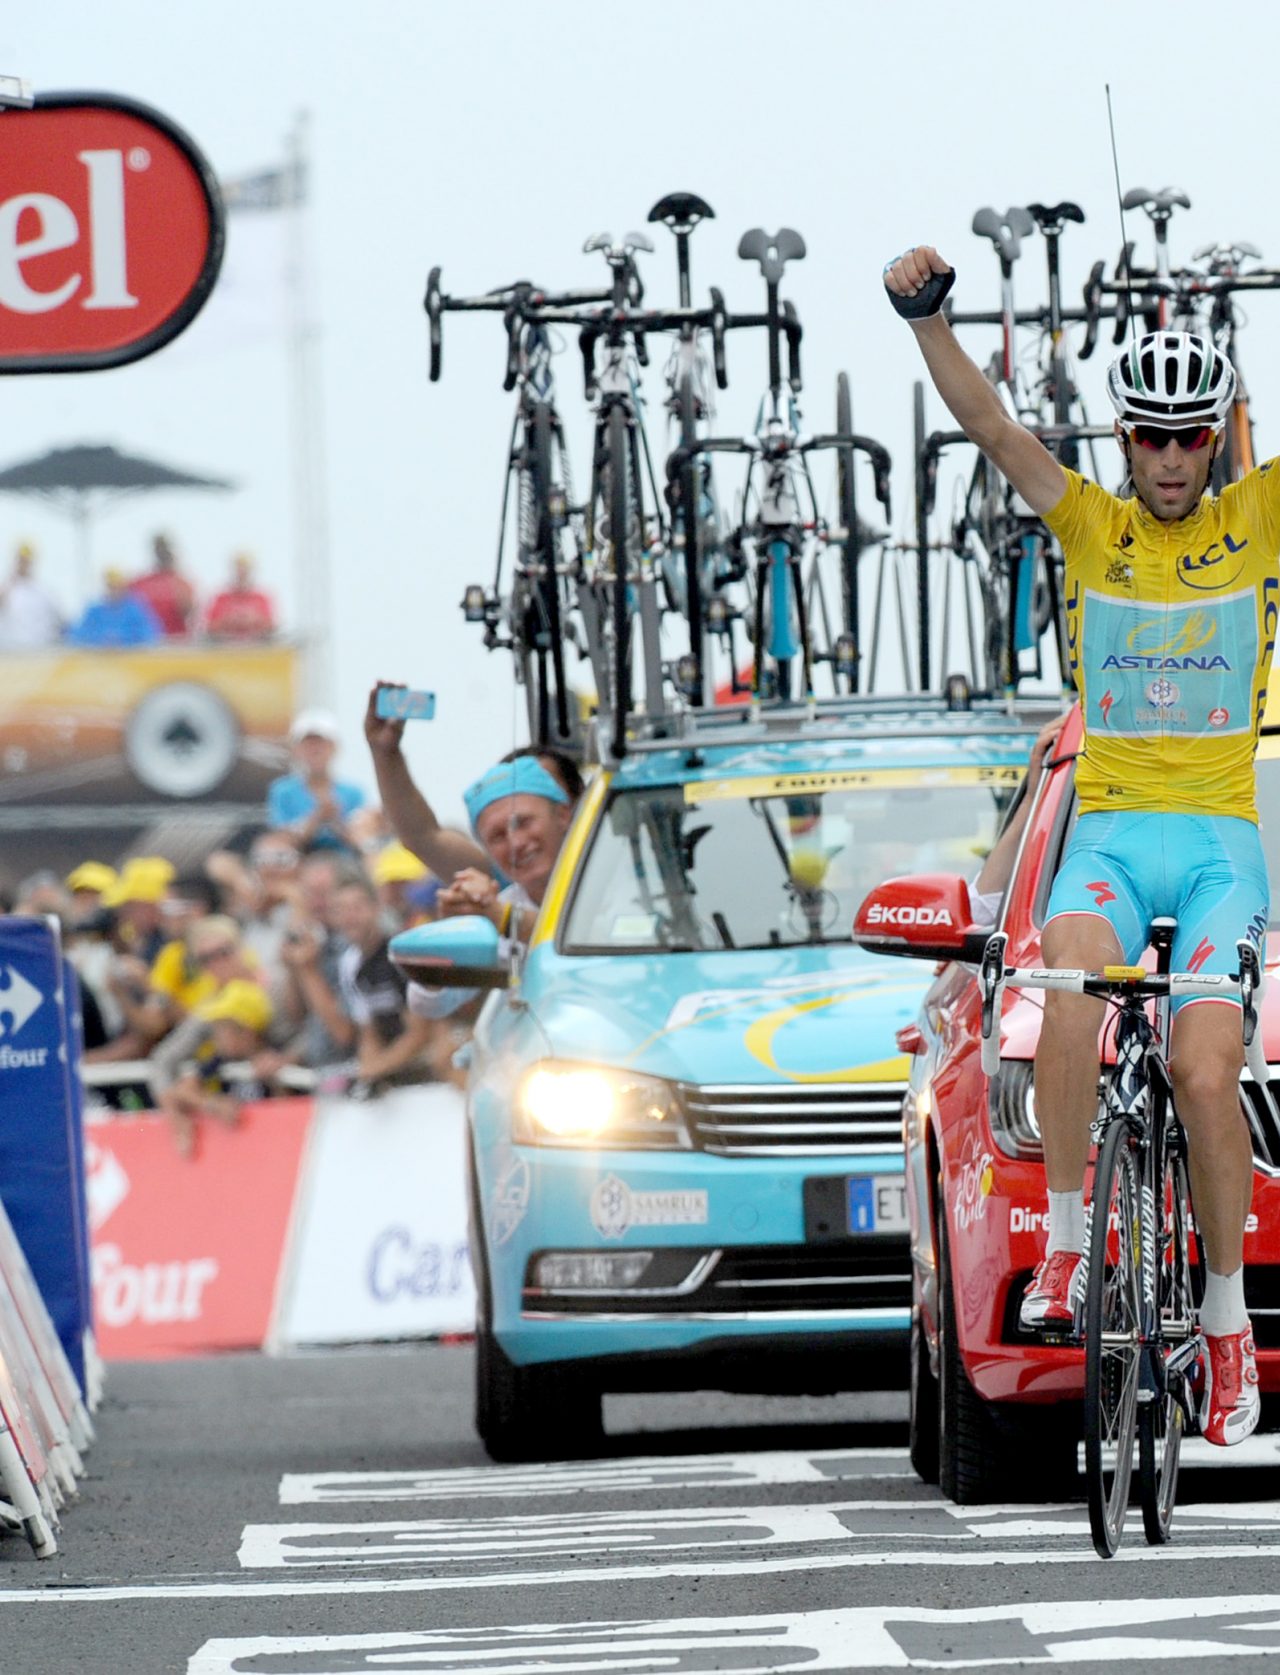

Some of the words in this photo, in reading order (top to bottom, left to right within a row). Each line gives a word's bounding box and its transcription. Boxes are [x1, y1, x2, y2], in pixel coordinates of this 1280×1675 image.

[1182, 533, 1248, 571] LCL
[1262, 577, 1280, 667] LCL
[1101, 655, 1232, 671] ASTANA
[977, 768, 1020, 782] 24
[866, 903, 953, 926] ŠKODA
